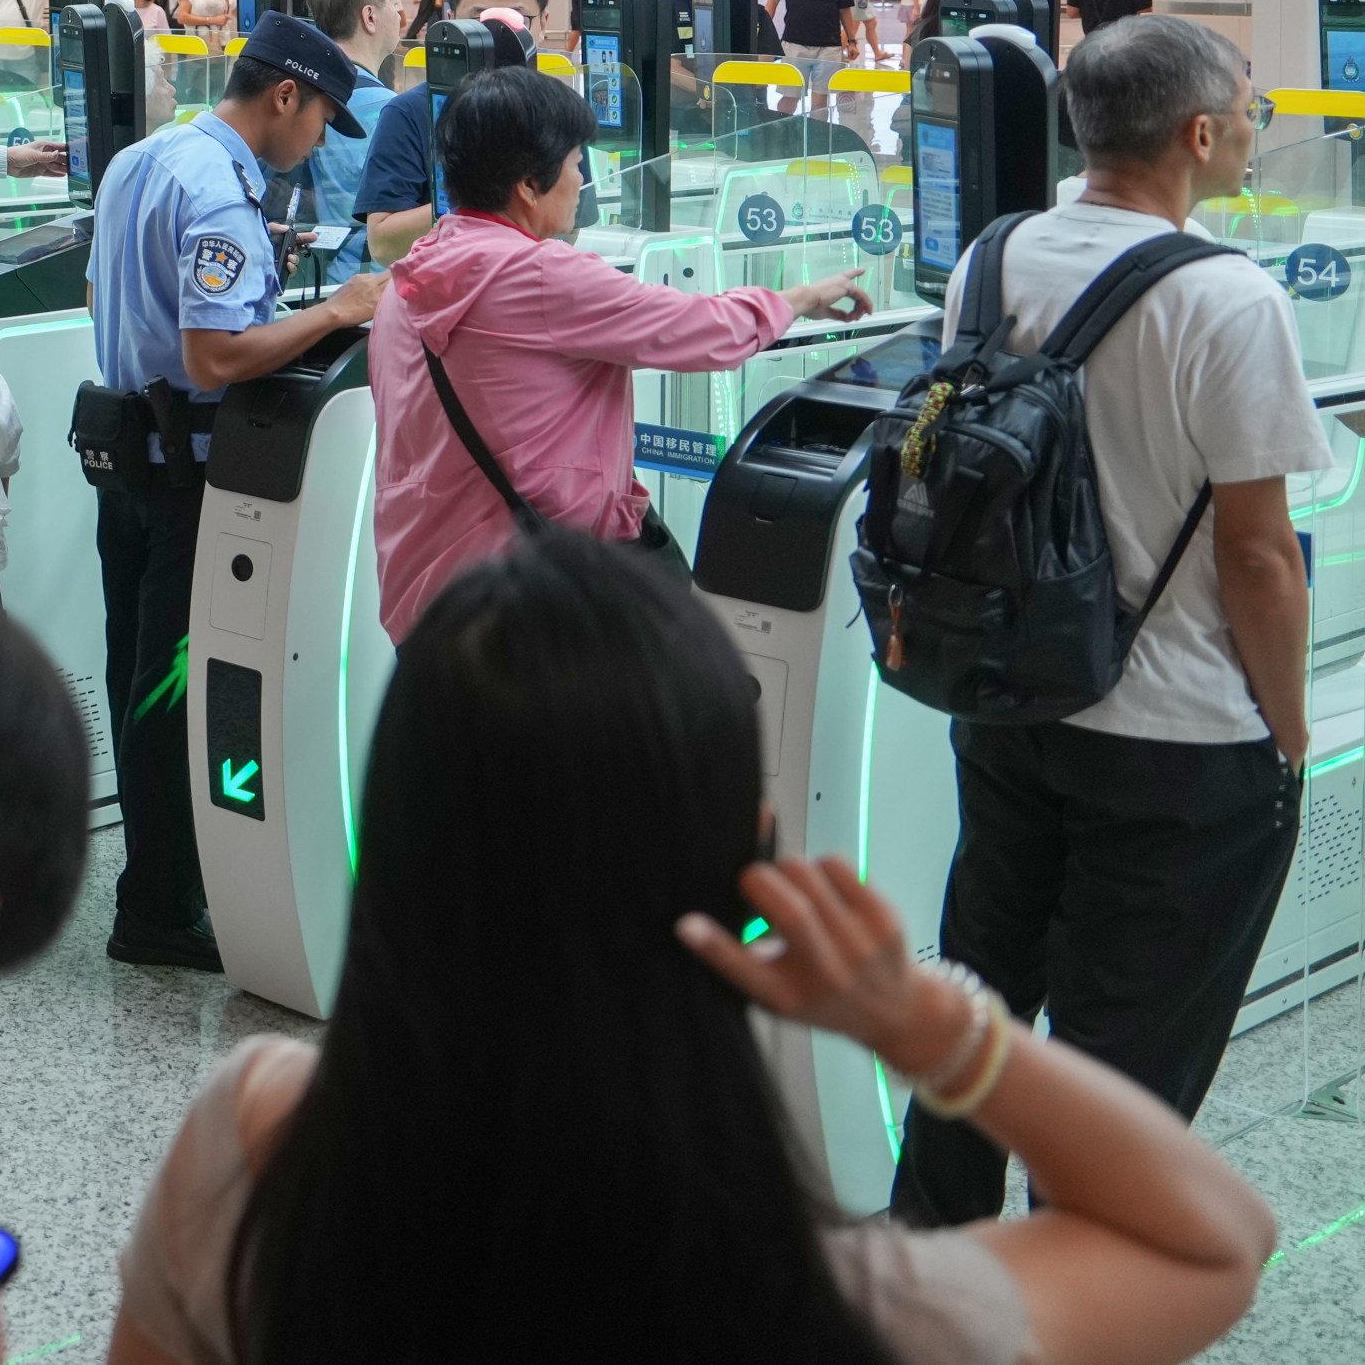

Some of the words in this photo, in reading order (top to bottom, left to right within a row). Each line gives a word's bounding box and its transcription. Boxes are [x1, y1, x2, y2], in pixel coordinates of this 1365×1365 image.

[284, 58, 320, 80] POLICE
[746, 207, 778, 232] 53
[860, 217, 894, 243] 53
[1297, 258, 1340, 288] 54
[640, 433, 717, 457] 中国移民管理
[641, 446, 664, 457] CHINA
[667, 451, 715, 465] IMMIGRATION
[84, 459, 113, 470] POLICE
